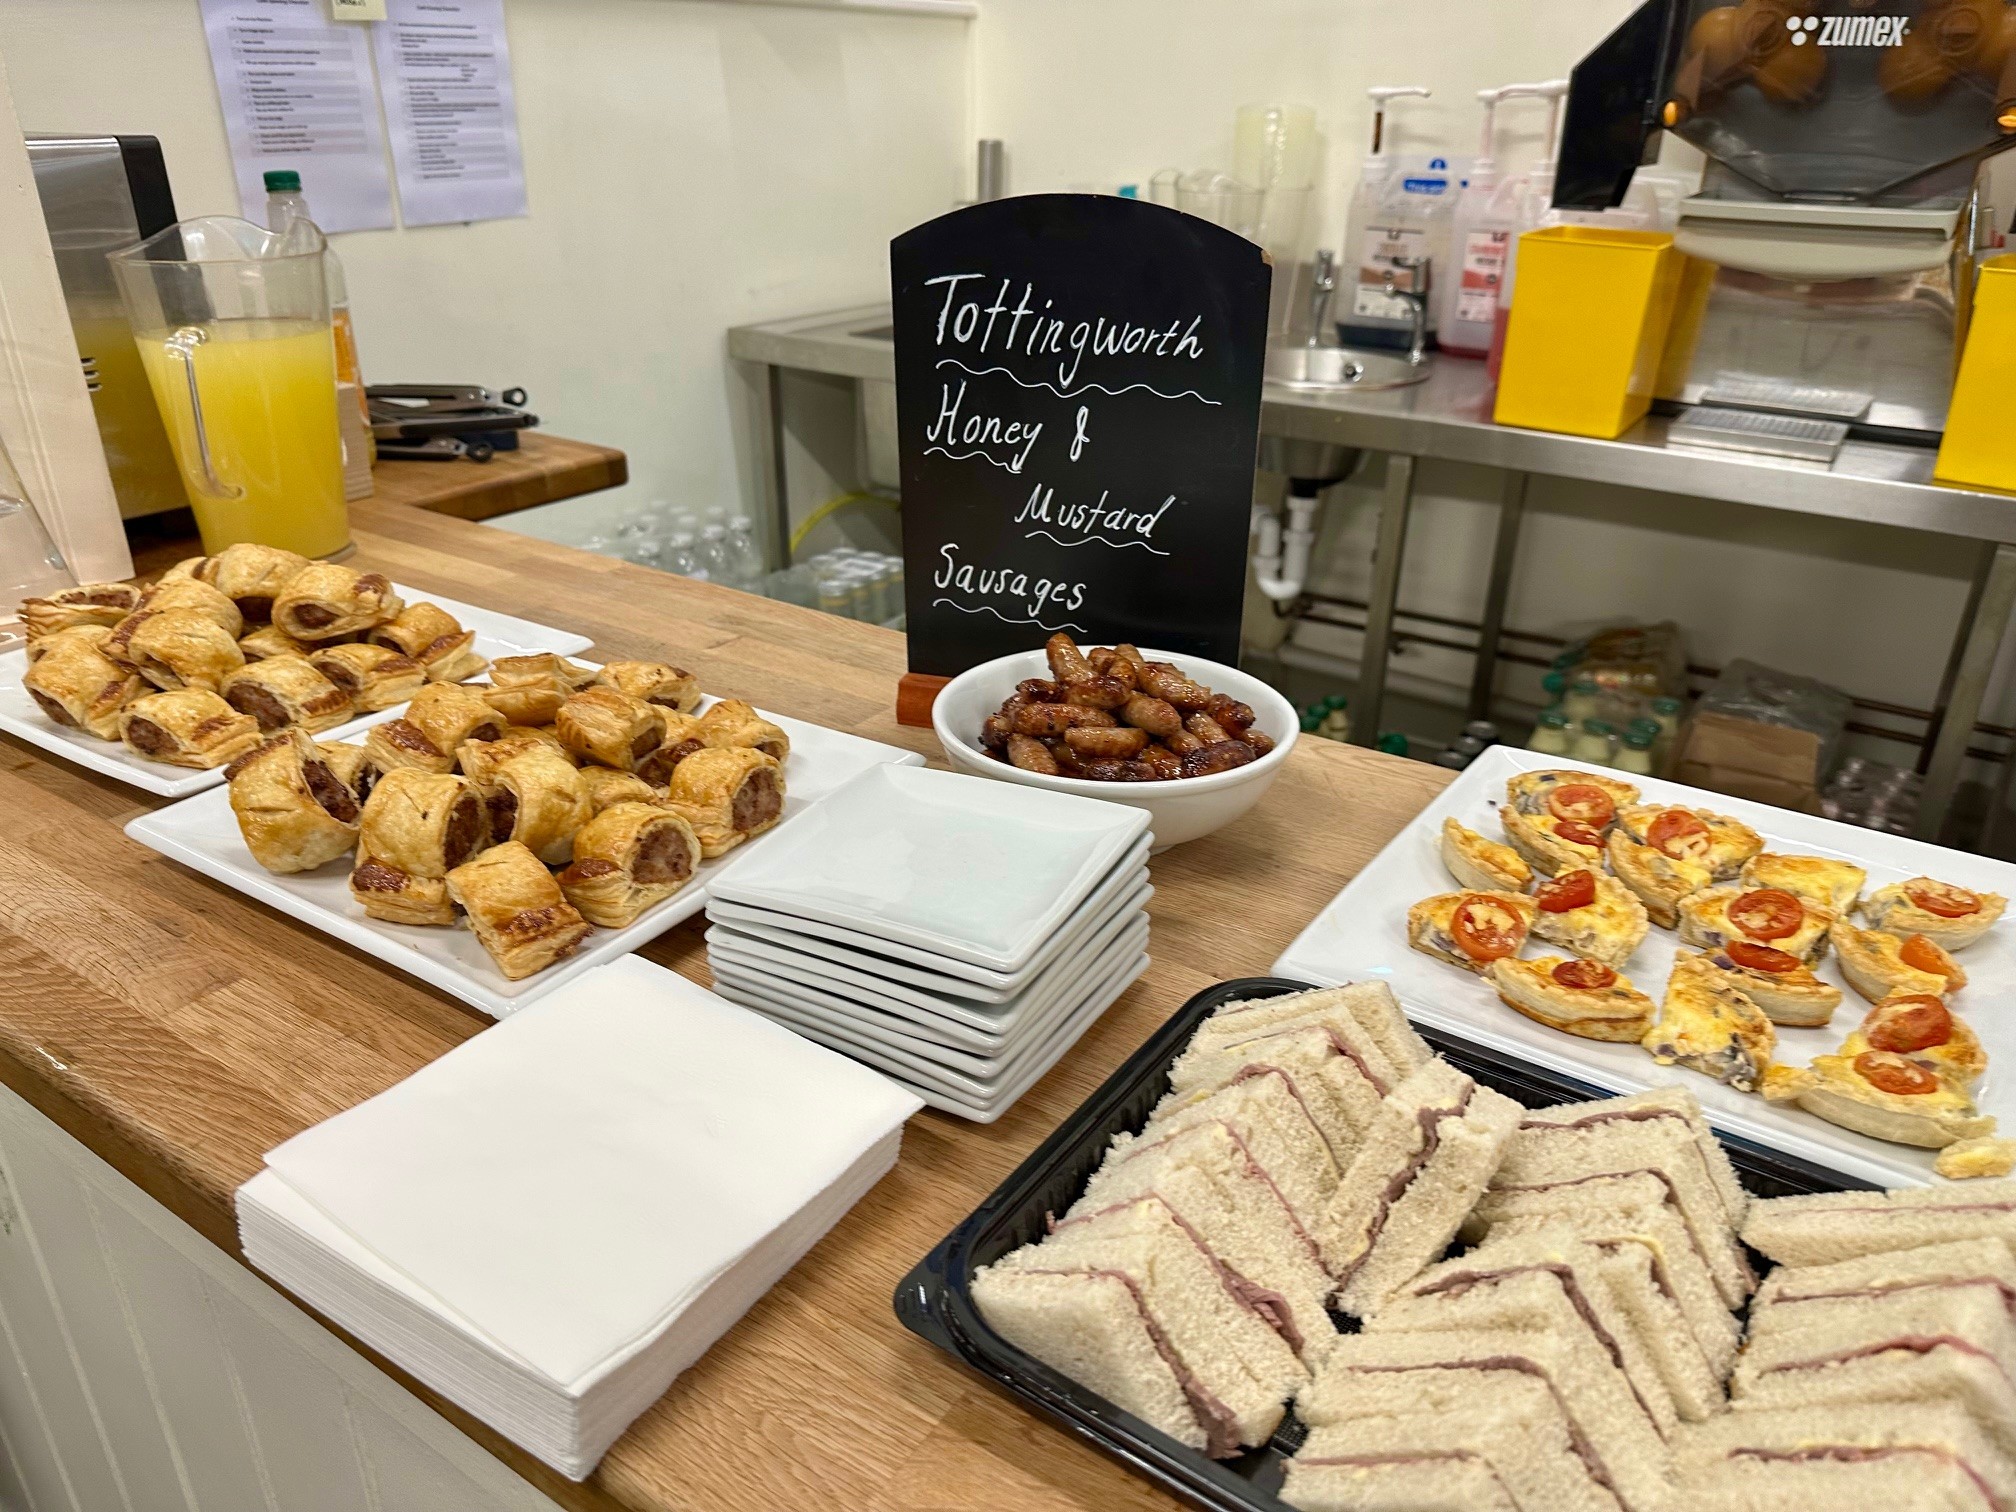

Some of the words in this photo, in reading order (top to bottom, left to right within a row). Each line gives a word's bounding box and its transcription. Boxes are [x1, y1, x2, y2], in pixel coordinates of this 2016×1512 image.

[1816, 16, 1910, 46] zumex
[925, 273, 1204, 388] Tottingworth
[926, 380, 1043, 471] Honey
[1070, 406, 1090, 461] &
[1014, 483, 1175, 538] Mustard
[934, 543, 1086, 616] Sausages
